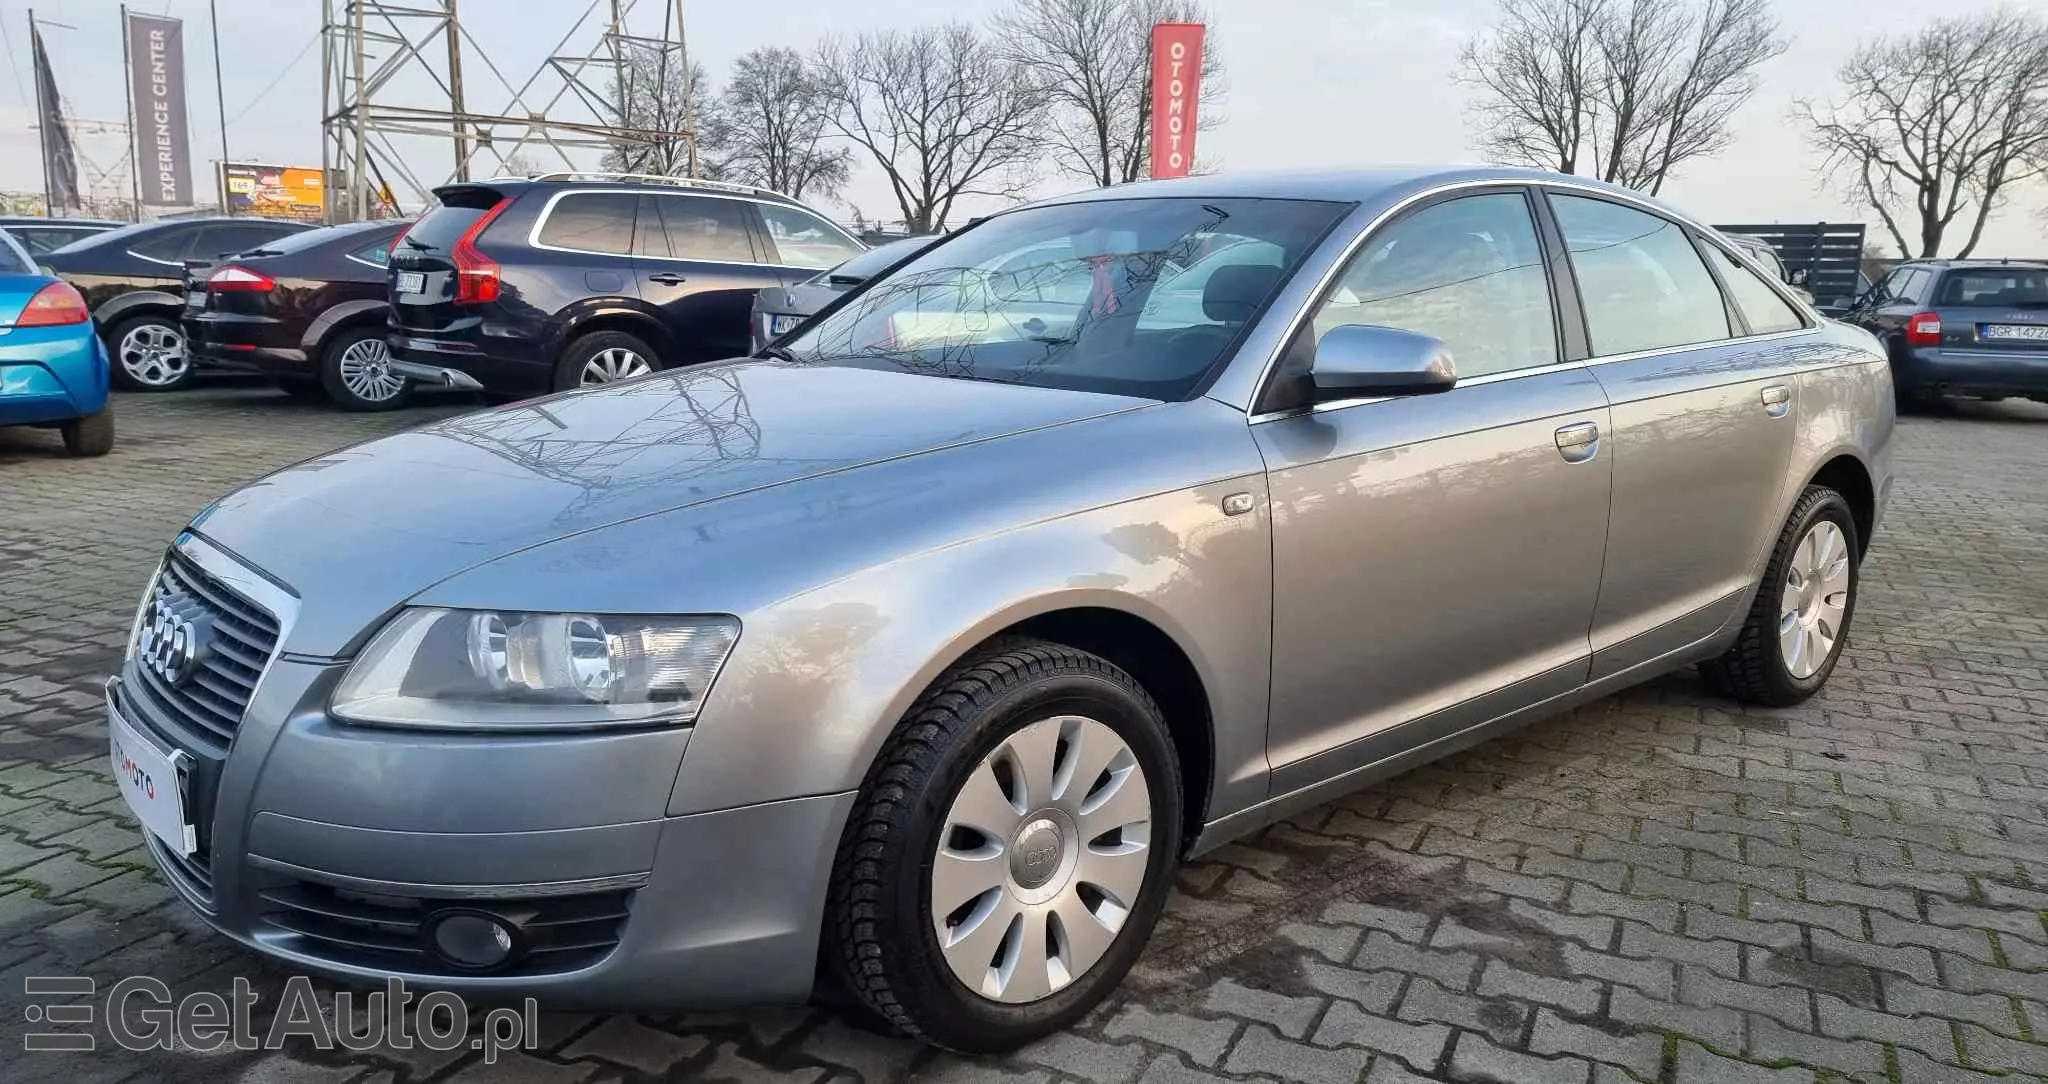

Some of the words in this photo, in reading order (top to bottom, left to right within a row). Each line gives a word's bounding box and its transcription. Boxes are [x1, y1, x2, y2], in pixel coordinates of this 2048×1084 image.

[150, 29, 167, 97] CENTER
[1169, 41, 1185, 169] OTOMOTO
[154, 102, 176, 201] EXPERIENCE
